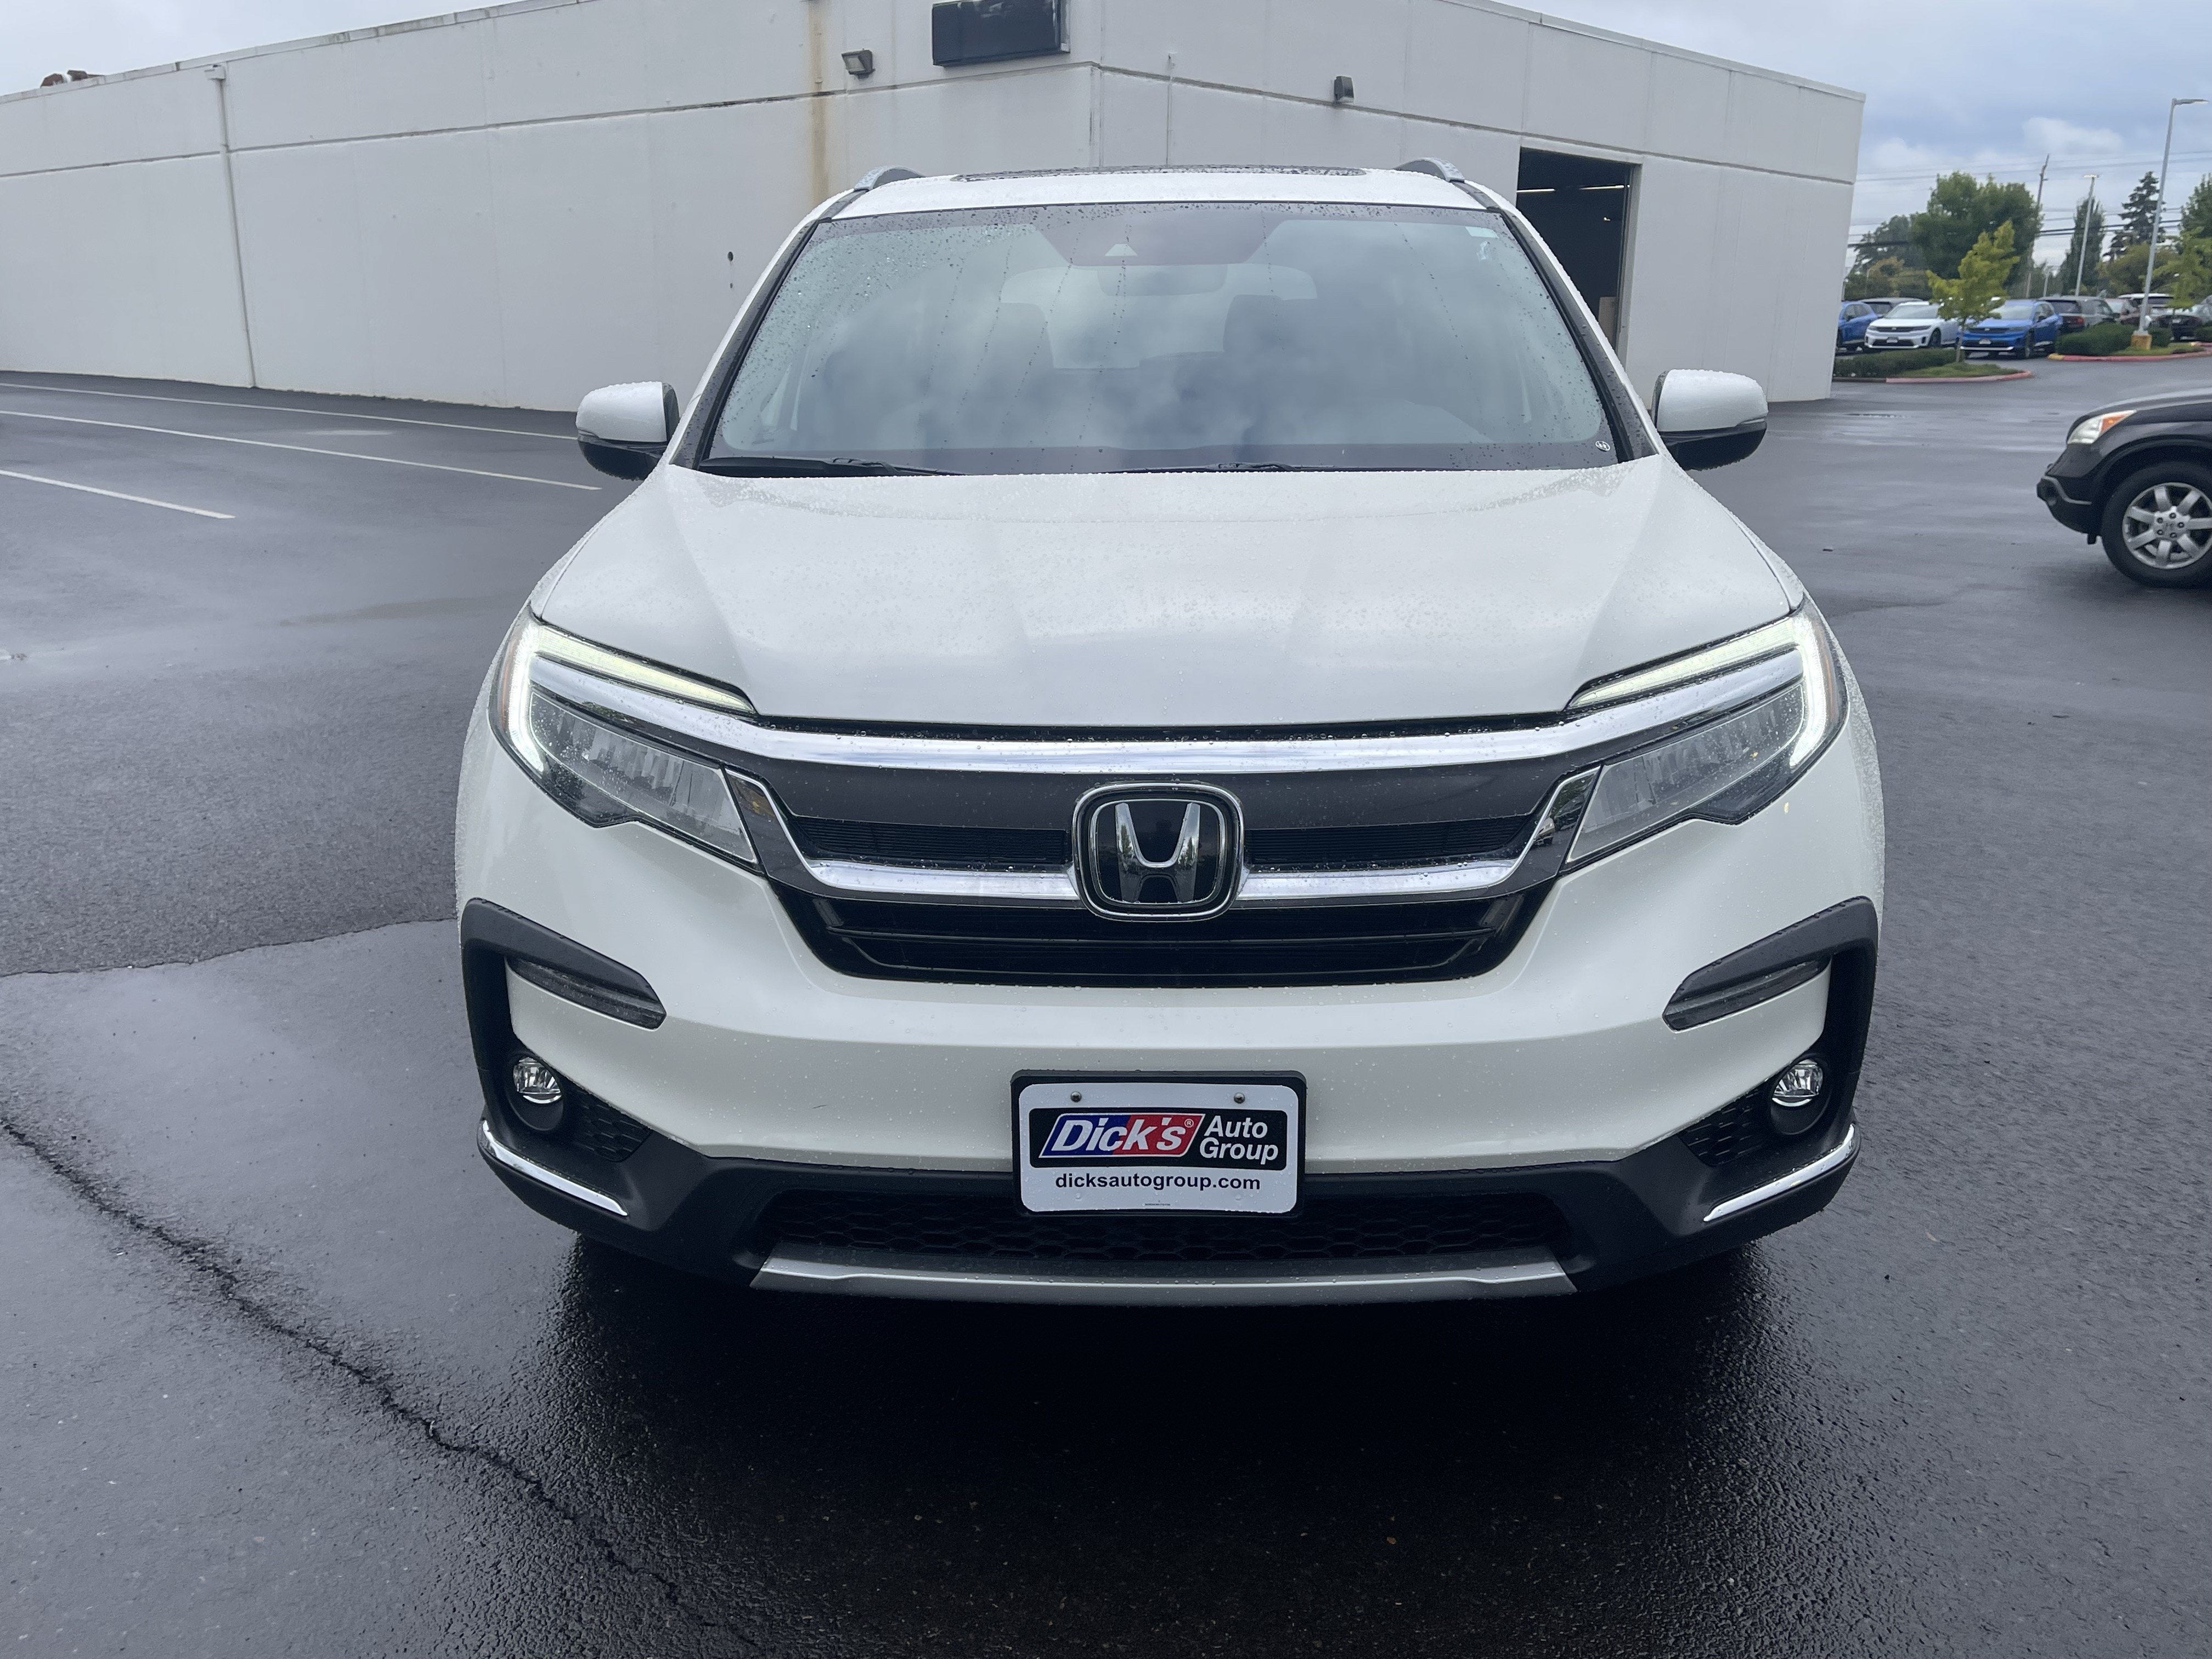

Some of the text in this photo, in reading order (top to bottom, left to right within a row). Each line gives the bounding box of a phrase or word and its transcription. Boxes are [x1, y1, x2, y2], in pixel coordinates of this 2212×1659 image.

[1115, 802, 1200, 904] H
[1204, 1115, 1268, 1138] Auto
[1199, 1137, 1279, 1165] Group
[1055, 1172, 1261, 1191] dicksautogroup.com
